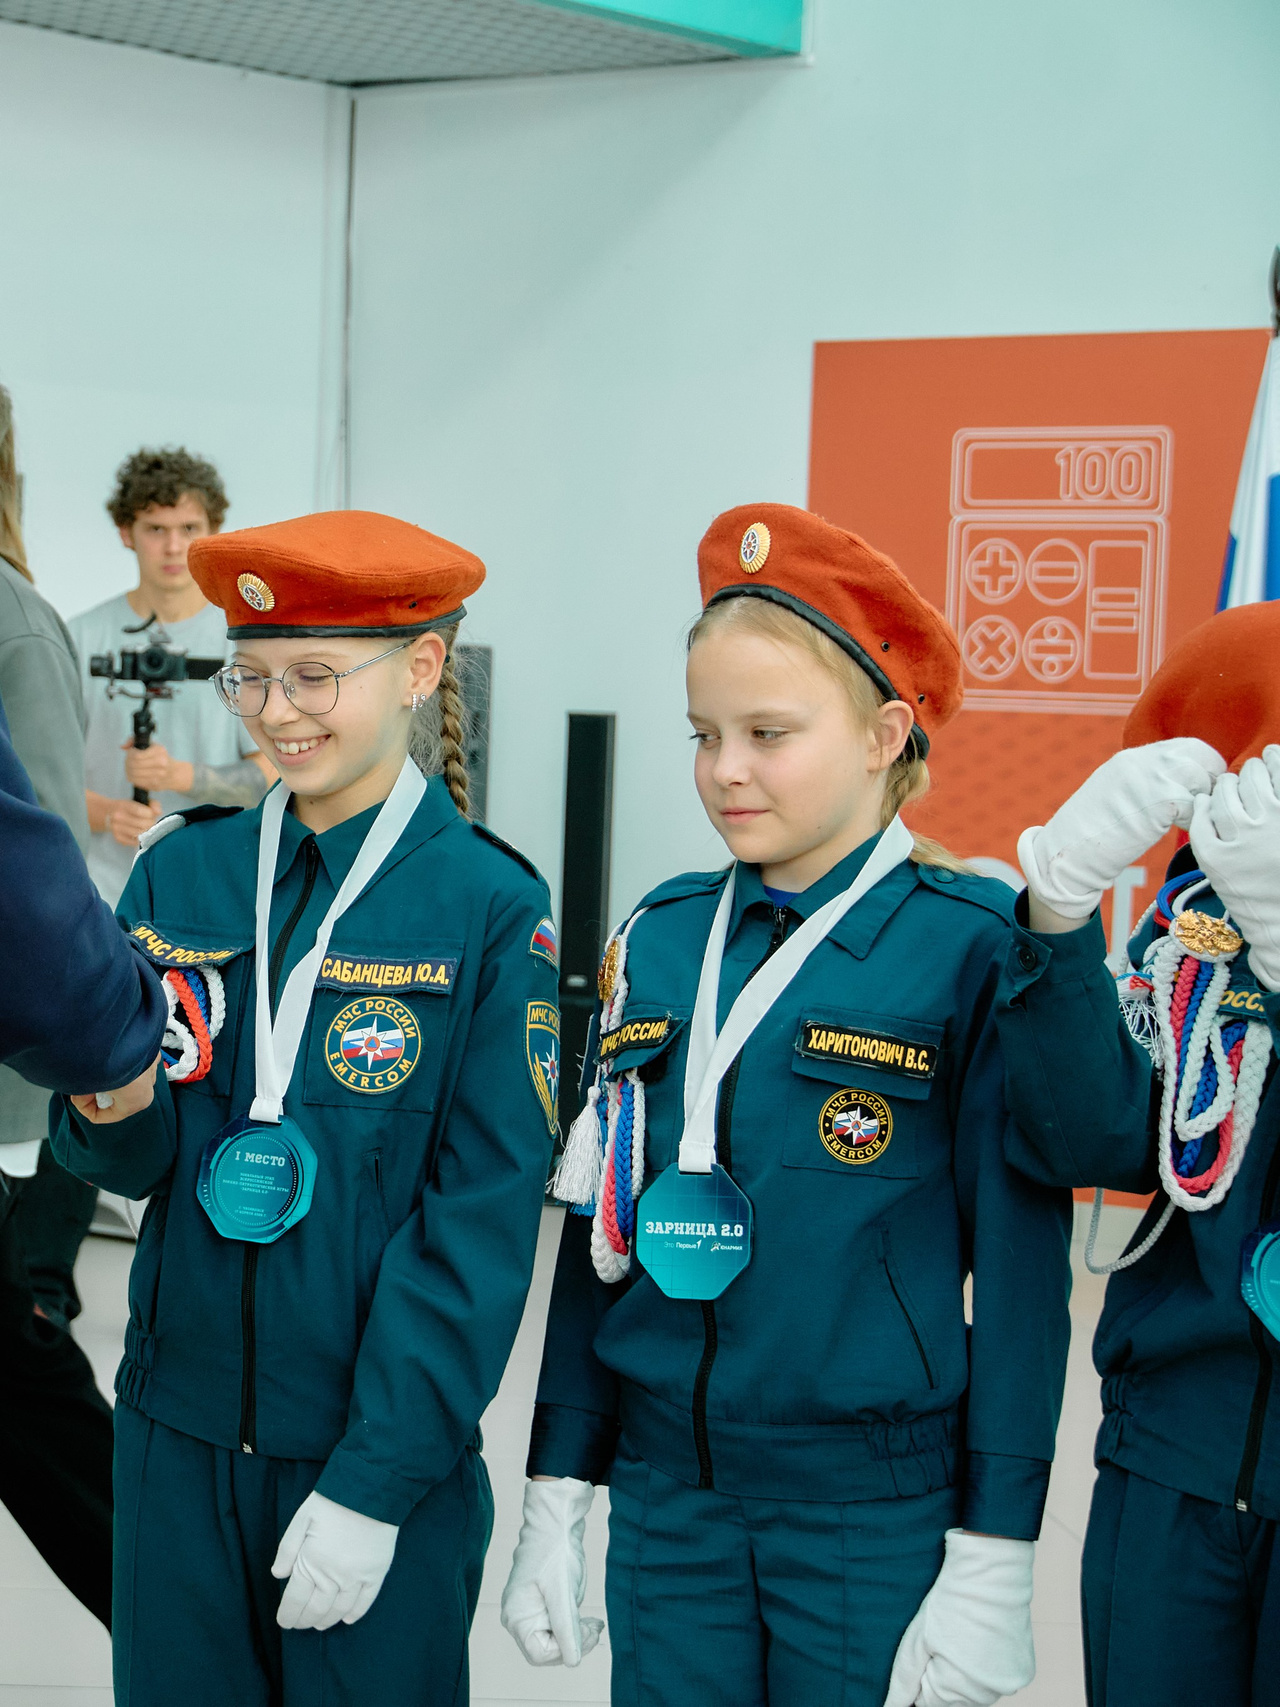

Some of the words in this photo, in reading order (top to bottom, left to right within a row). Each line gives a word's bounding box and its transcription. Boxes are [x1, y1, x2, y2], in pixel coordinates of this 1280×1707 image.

[1055, 445, 1150, 502] 100
[131, 926, 171, 957] МЧС
[165, 947, 235, 964] РОССИИ
[321, 957, 413, 988] САБАНЦЕВА
[414, 963, 450, 986] Ю.А.
[334, 1004, 362, 1034] МЧС
[365, 1000, 417, 1039] РОССИИ
[531, 1007, 548, 1023] МЧС
[600, 1035, 620, 1057] МЧС
[618, 1019, 669, 1046] РОССИИ
[808, 1028, 905, 1066] ХАРИТОНОВИЧ
[904, 1047, 930, 1072] В.С.
[330, 1052, 413, 1088] EMERCOM
[826, 1095, 847, 1119] МЧС
[850, 1092, 888, 1126] РОССИИ
[825, 1134, 883, 1159] EMERCOM
[645, 1221, 717, 1238] ЗАРНИЦА
[721, 1224, 744, 1237] 2.0
